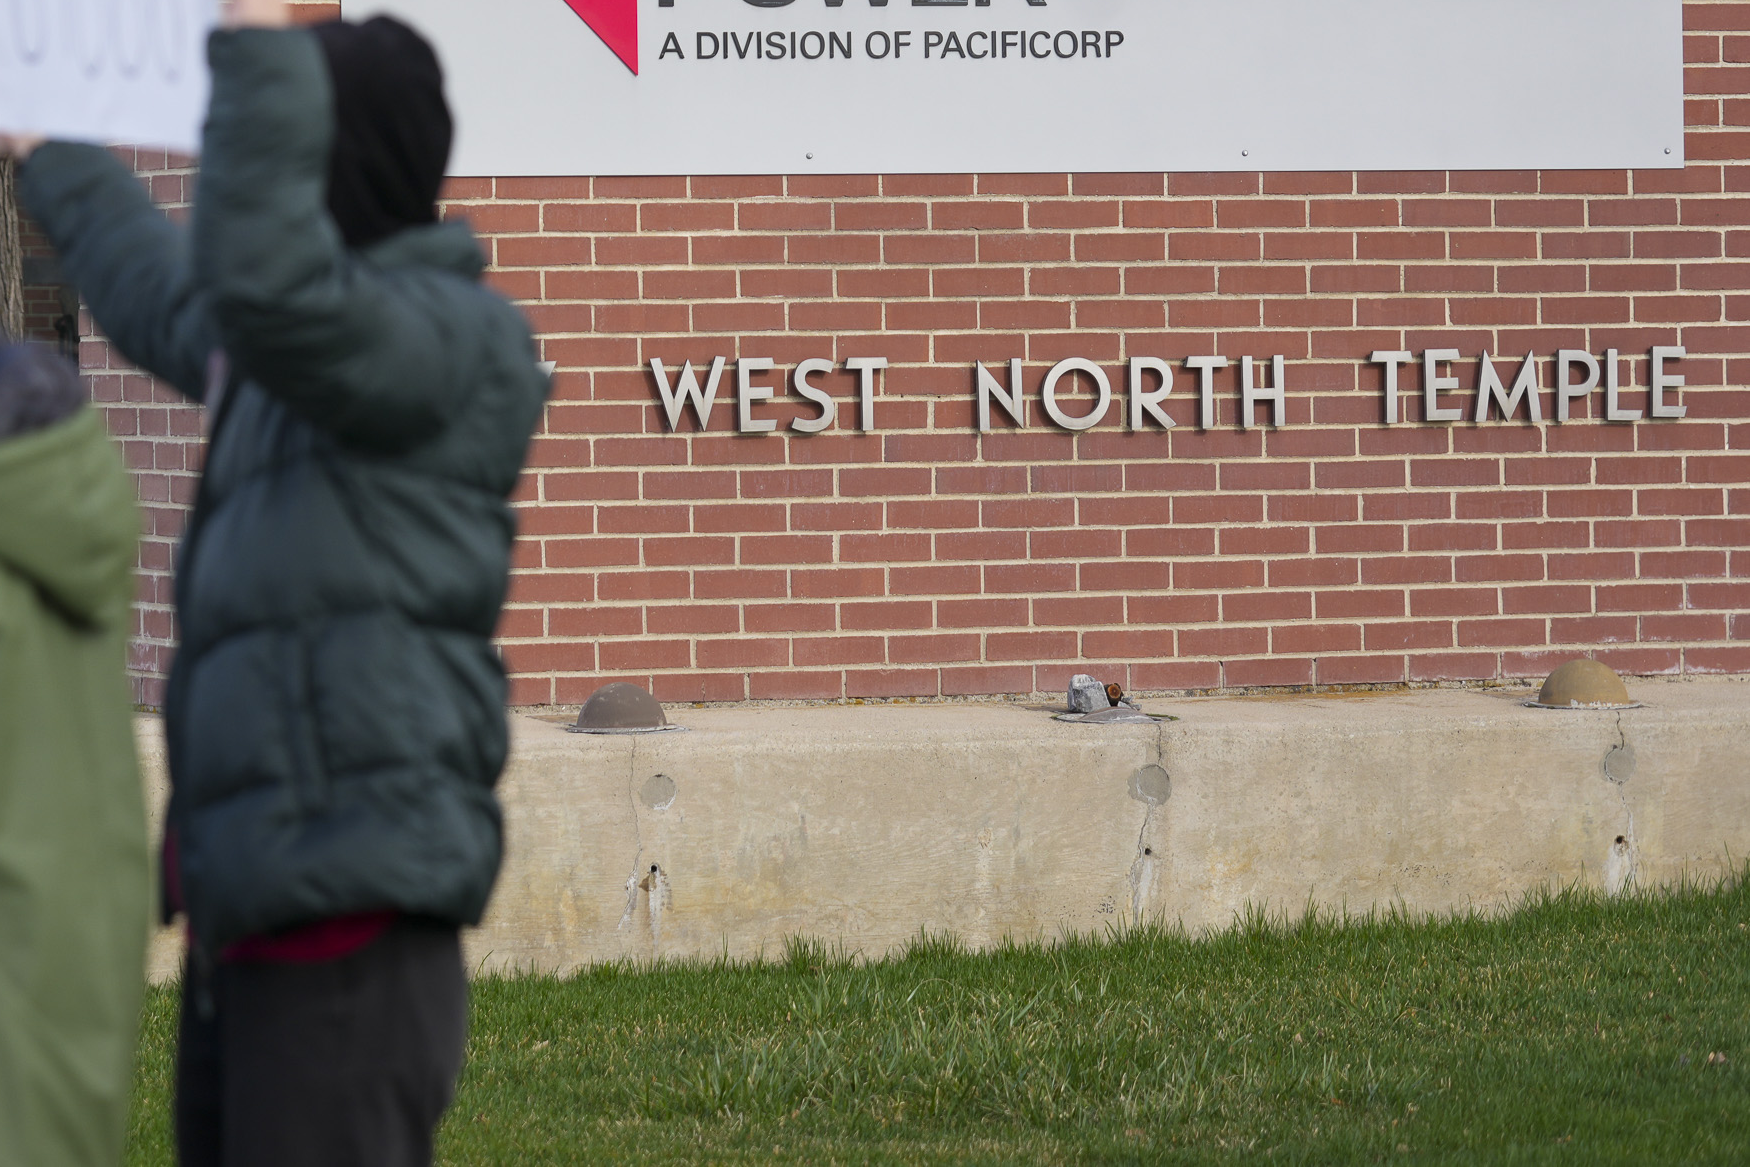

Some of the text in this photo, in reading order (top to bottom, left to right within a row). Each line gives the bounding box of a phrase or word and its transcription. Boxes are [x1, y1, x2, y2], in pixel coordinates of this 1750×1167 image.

[658, 30, 1126, 60] A DIVISION OF PACIFICORP
[650, 345, 1688, 433] WEST NORTH TEMPLE
